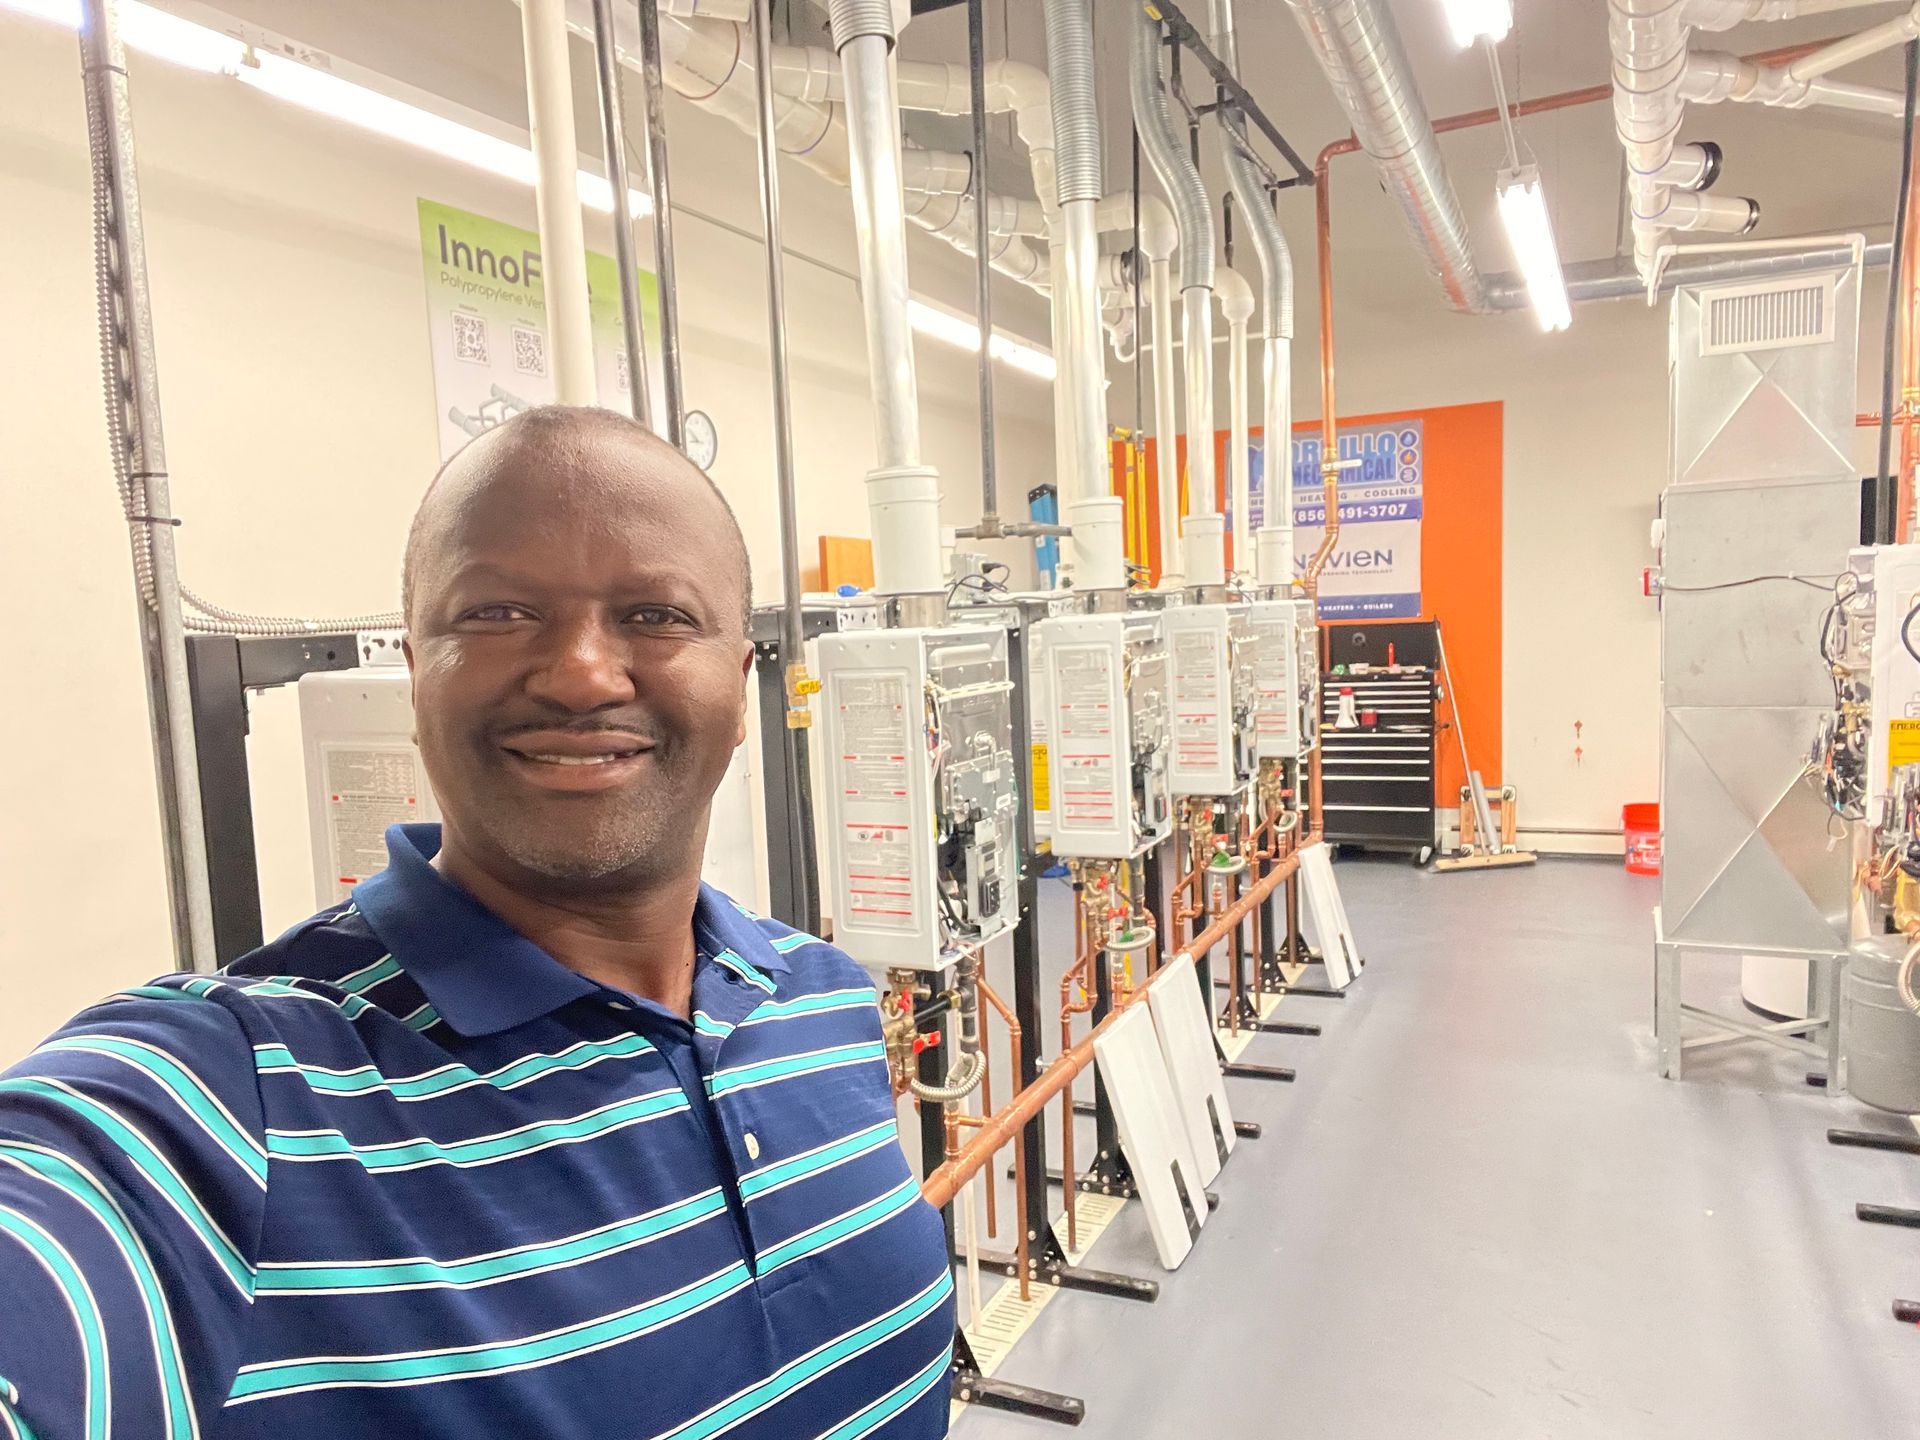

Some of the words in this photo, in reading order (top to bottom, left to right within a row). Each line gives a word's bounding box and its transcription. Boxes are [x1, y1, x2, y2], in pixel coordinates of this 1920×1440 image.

[439, 224, 542, 288] InnoF
[441, 271, 523, 305] Polypropylene
[1292, 457, 1394, 486] MECANICAL
[1300, 492, 1348, 503] HEAG
[1364, 487, 1416, 498] COOLING
[1293, 509, 1325, 524] (856
